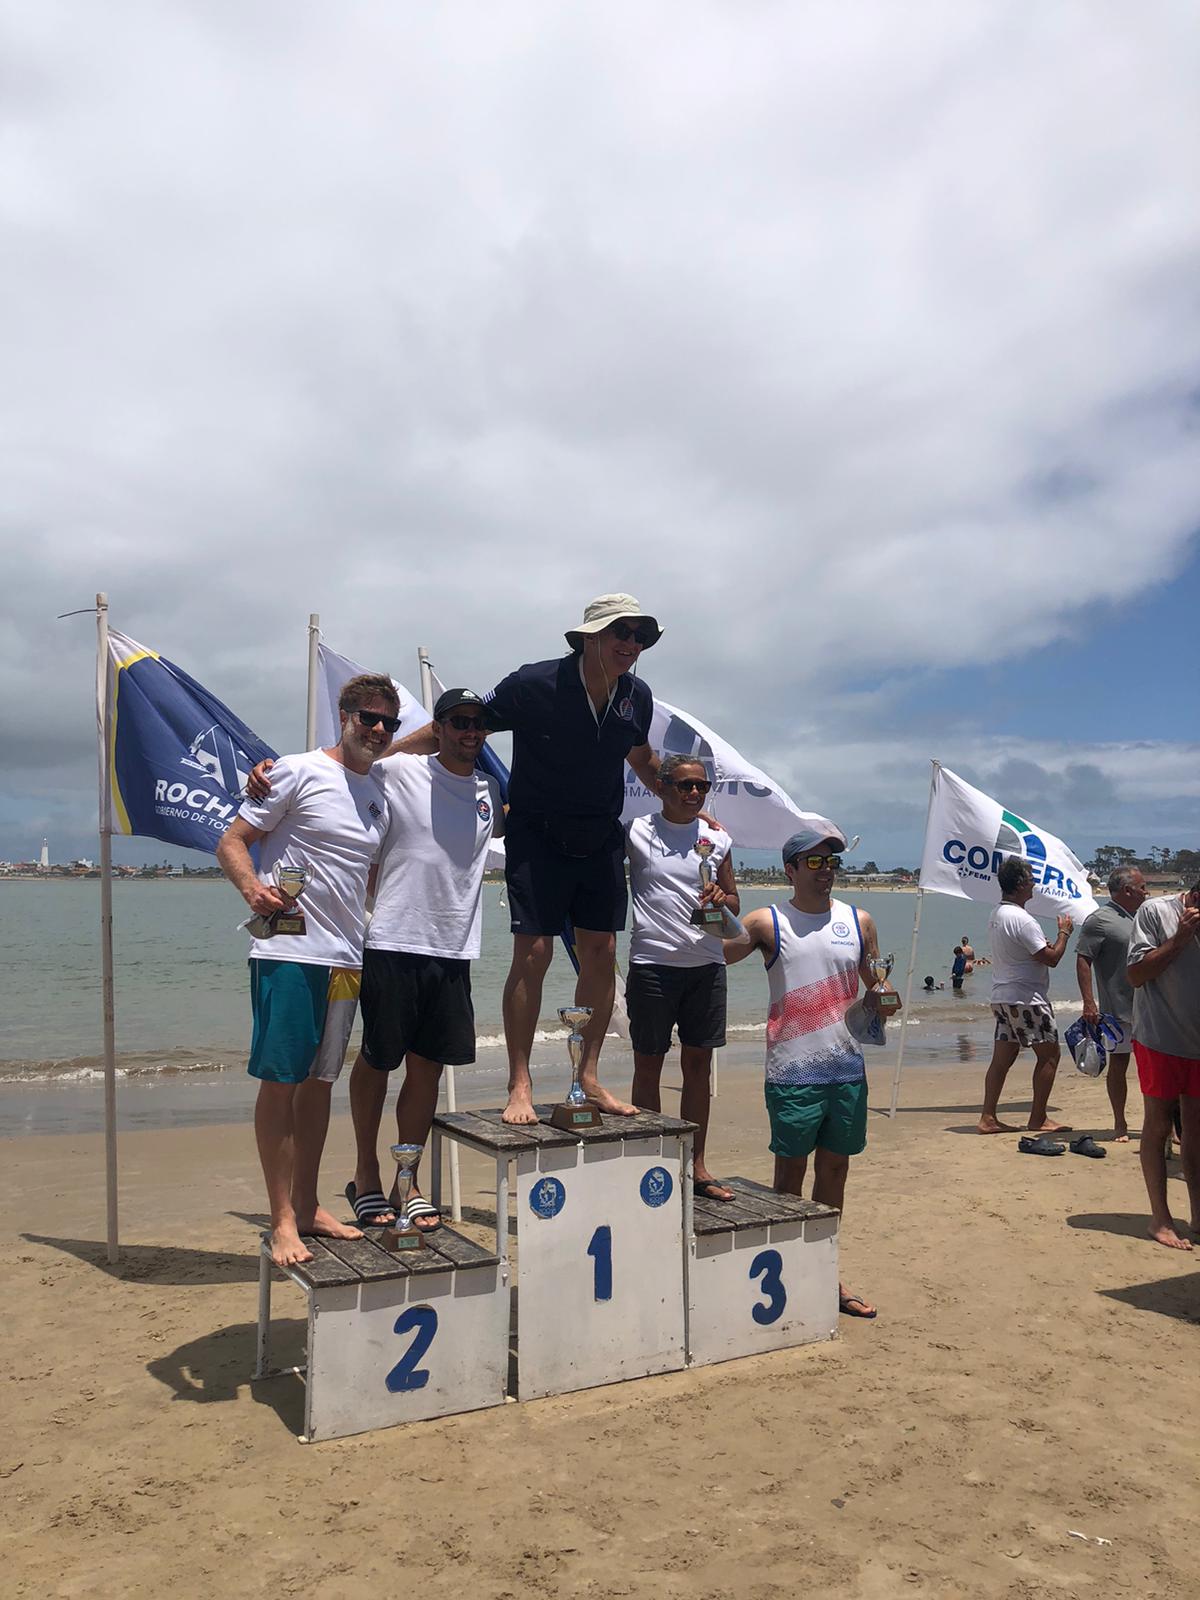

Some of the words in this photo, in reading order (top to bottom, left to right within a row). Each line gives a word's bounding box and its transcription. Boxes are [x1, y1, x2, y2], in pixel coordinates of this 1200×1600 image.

[190, 812, 207, 824] DE
[968, 870, 991, 882] FEMI
[587, 1225, 612, 1302] 1
[748, 1249, 787, 1326] 3
[385, 1304, 438, 1393] 2
